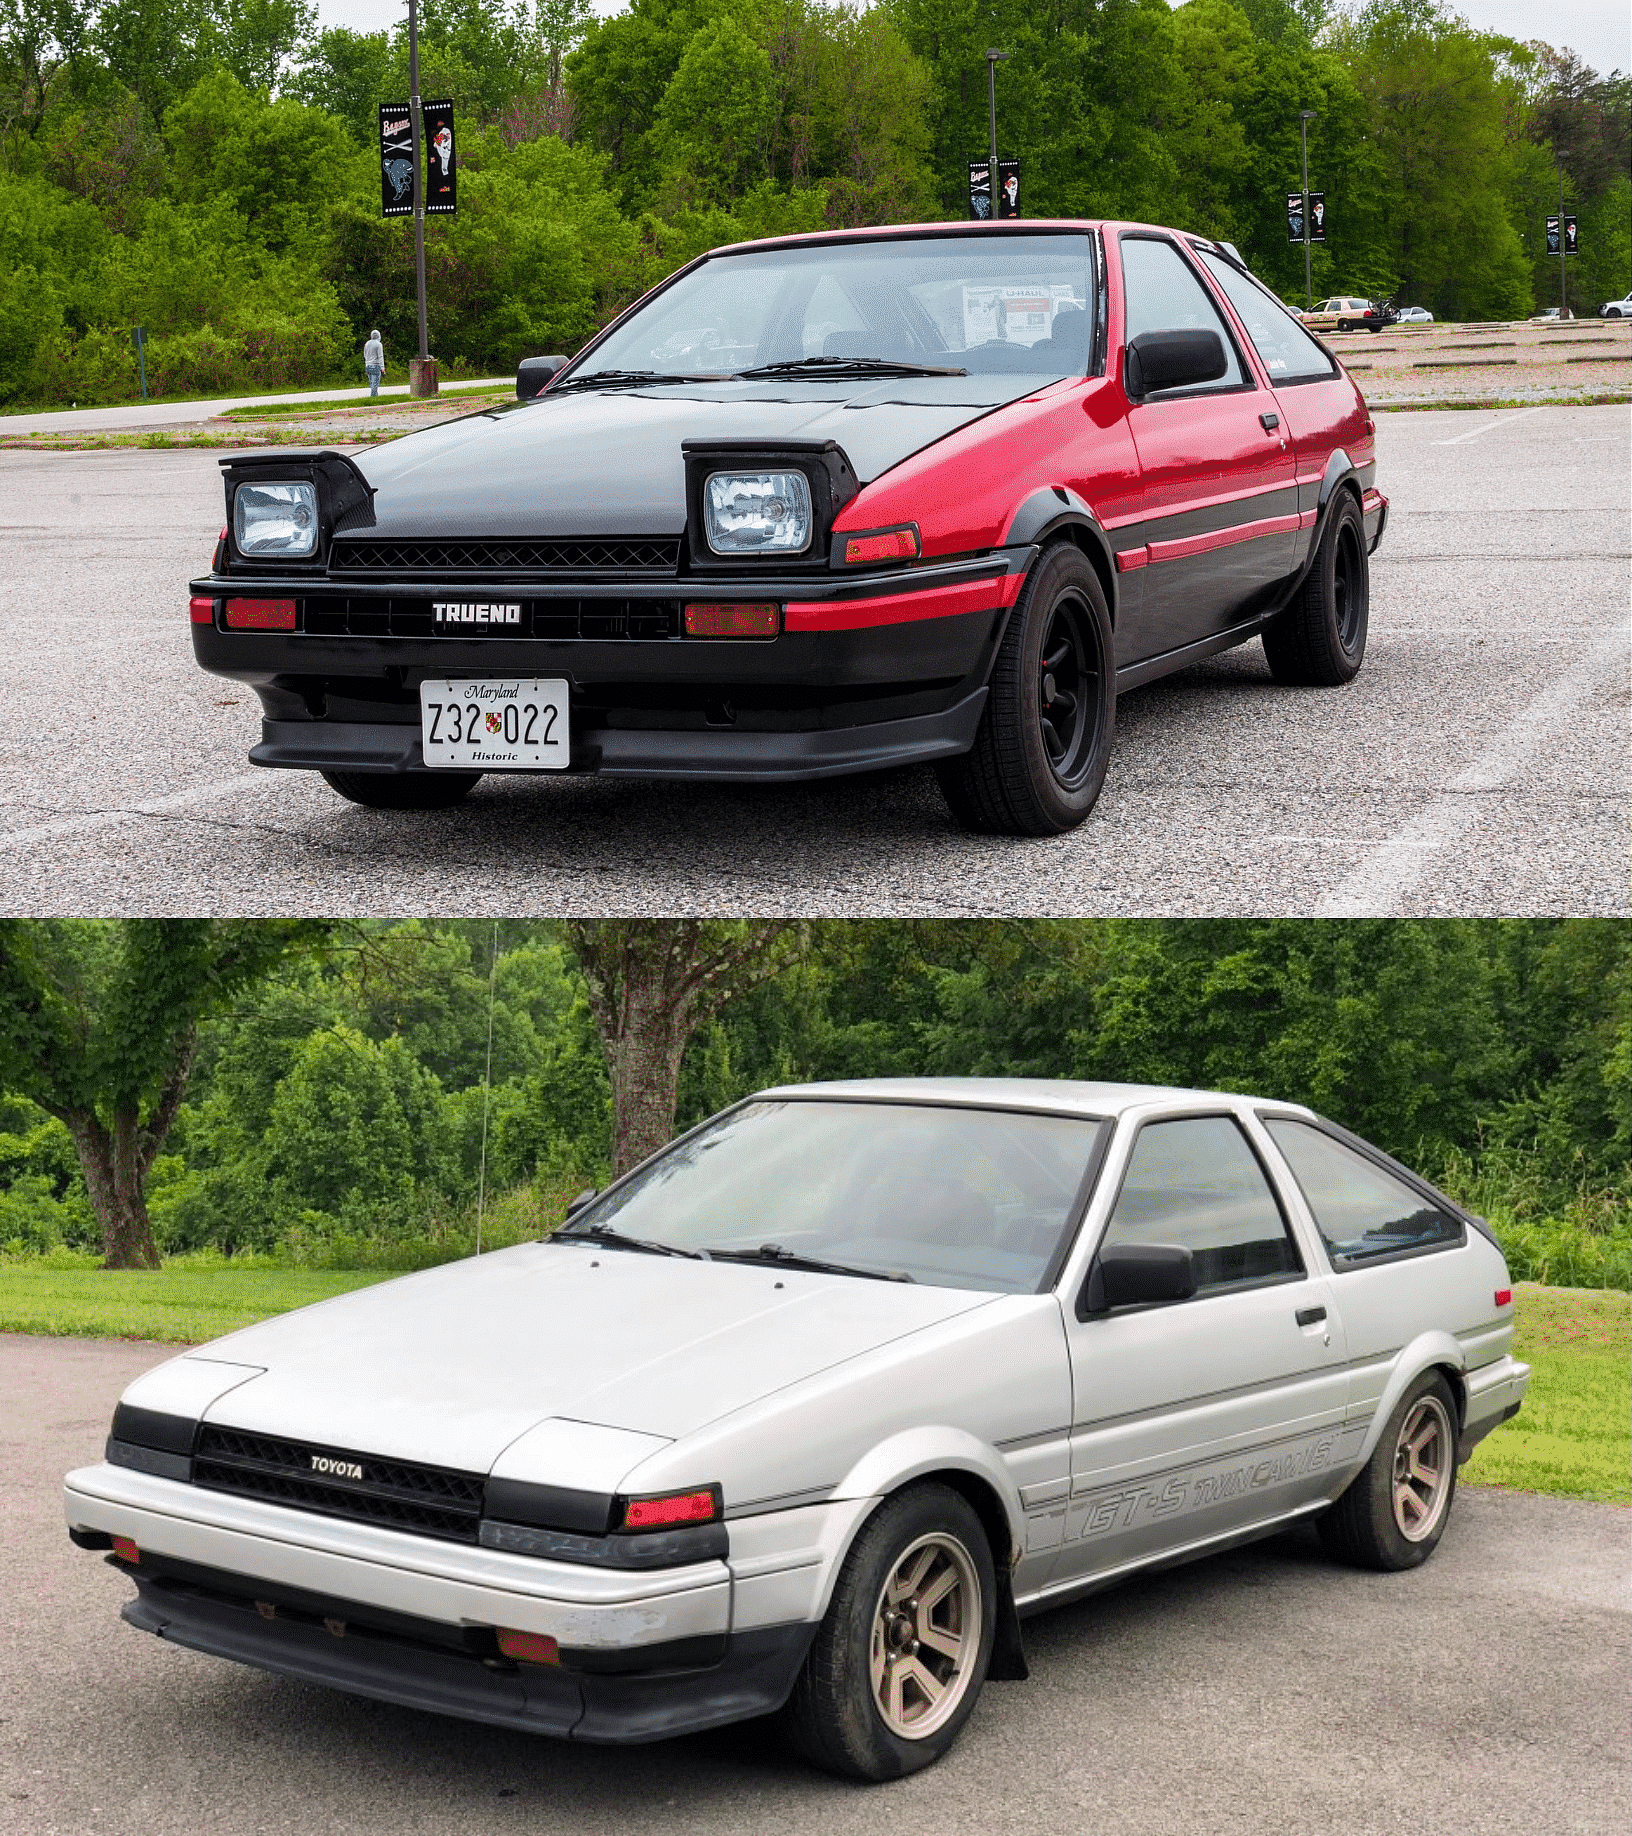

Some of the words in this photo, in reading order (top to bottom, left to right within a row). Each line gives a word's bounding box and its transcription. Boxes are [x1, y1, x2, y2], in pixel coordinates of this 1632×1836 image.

[432, 603, 521, 622] TRUENO
[464, 684, 520, 703] Maryland
[472, 752, 519, 761] Historic
[311, 1455, 363, 1479] TOYOTA
